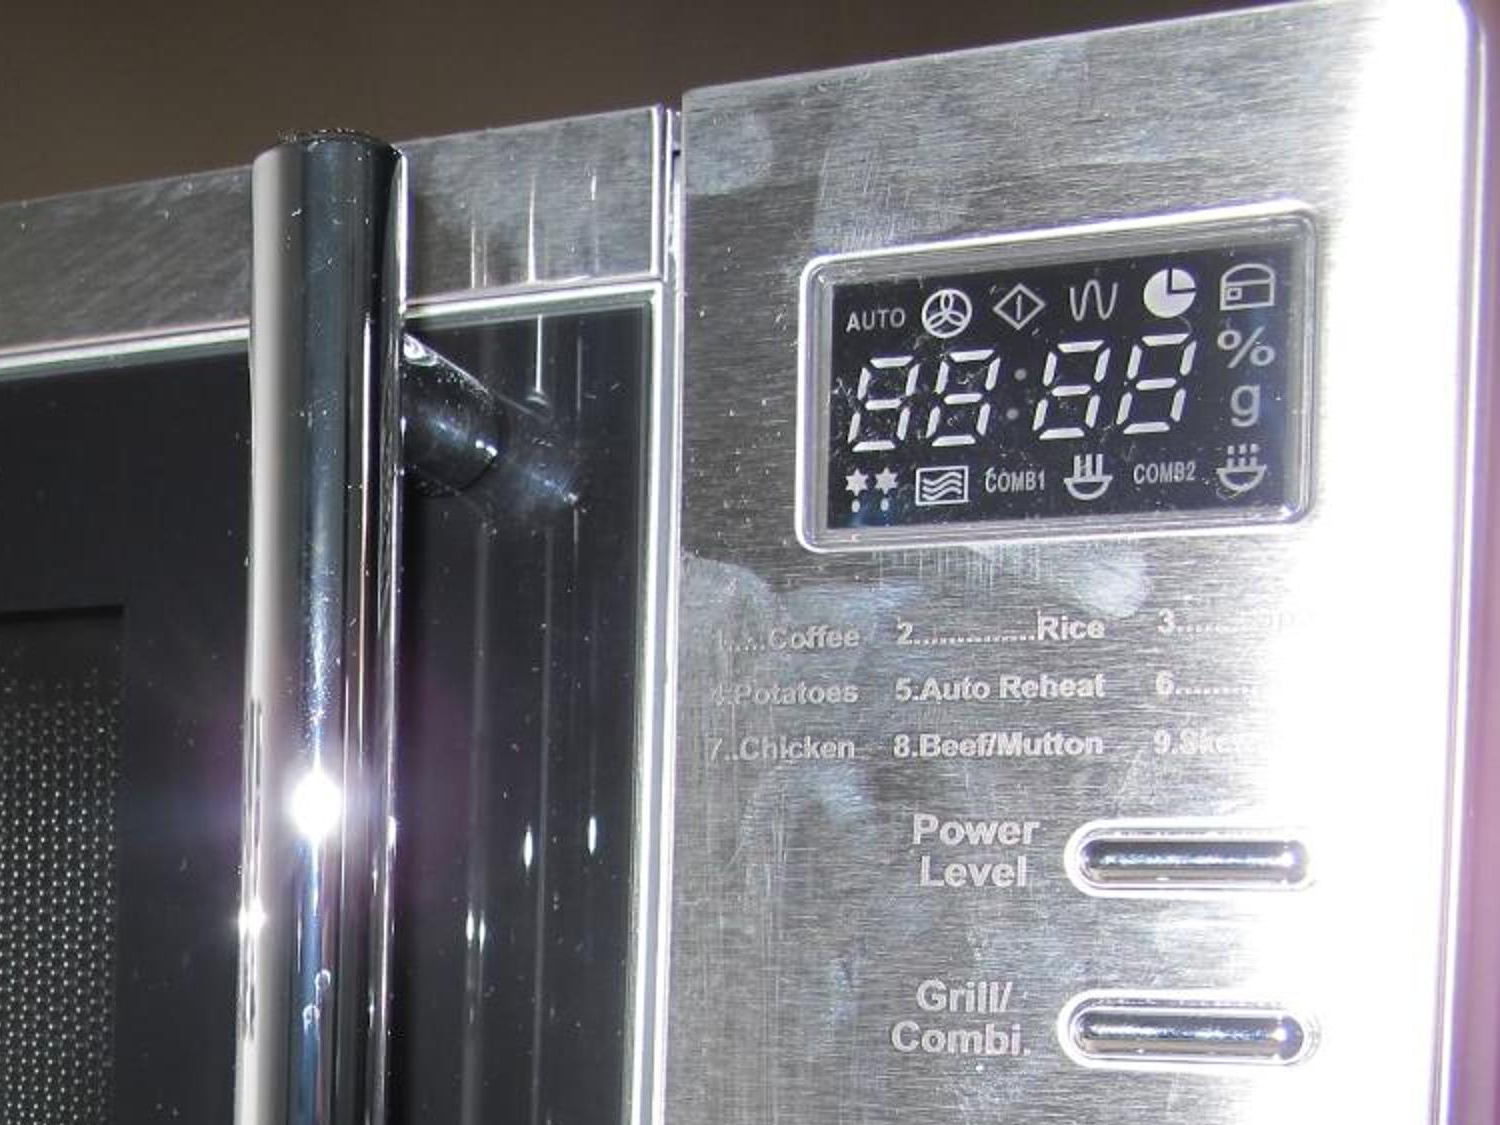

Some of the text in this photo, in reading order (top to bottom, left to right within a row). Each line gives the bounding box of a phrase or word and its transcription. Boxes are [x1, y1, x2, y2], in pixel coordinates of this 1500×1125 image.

[846, 308, 905, 332] AUTO
[1216, 327, 1276, 368] %
[1230, 383, 1262, 427] g
[985, 468, 1046, 493] COMB1
[1133, 460, 1197, 485] COMB2
[999, 672, 1107, 699] Reheat
[912, 813, 1041, 845] Power
[920, 855, 1027, 888] Level
[916, 978, 1013, 1013] Grill/
